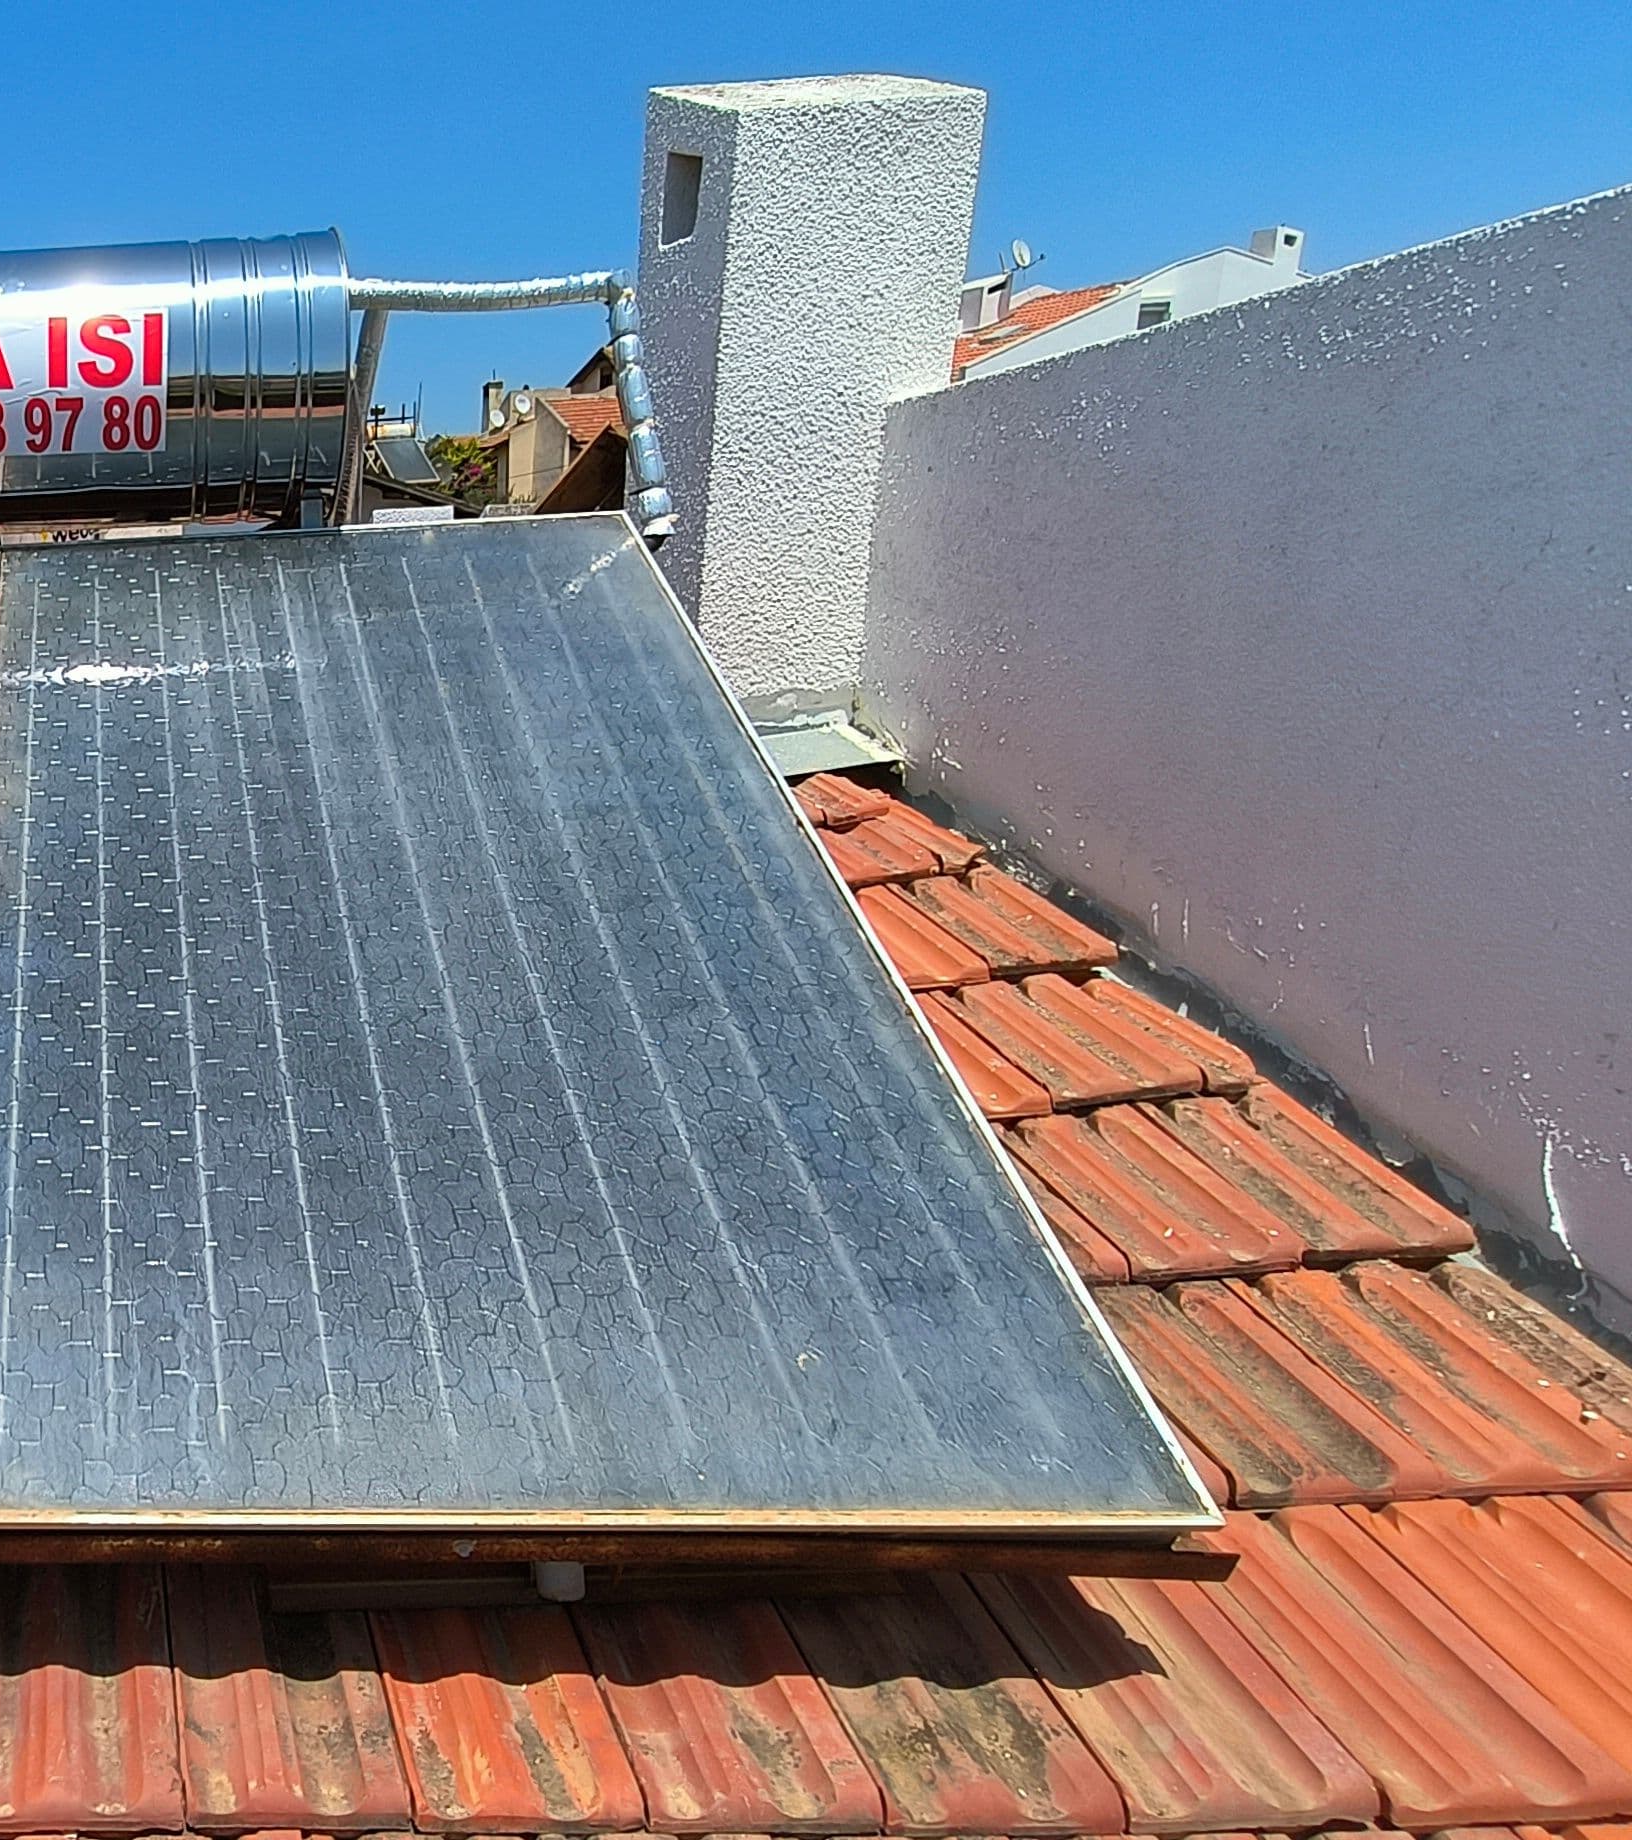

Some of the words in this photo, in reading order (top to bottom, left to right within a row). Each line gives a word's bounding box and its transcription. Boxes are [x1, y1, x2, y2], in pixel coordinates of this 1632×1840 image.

[48, 312, 164, 389] ISI
[24, 396, 85, 453] 97
[102, 395, 163, 452] 80
